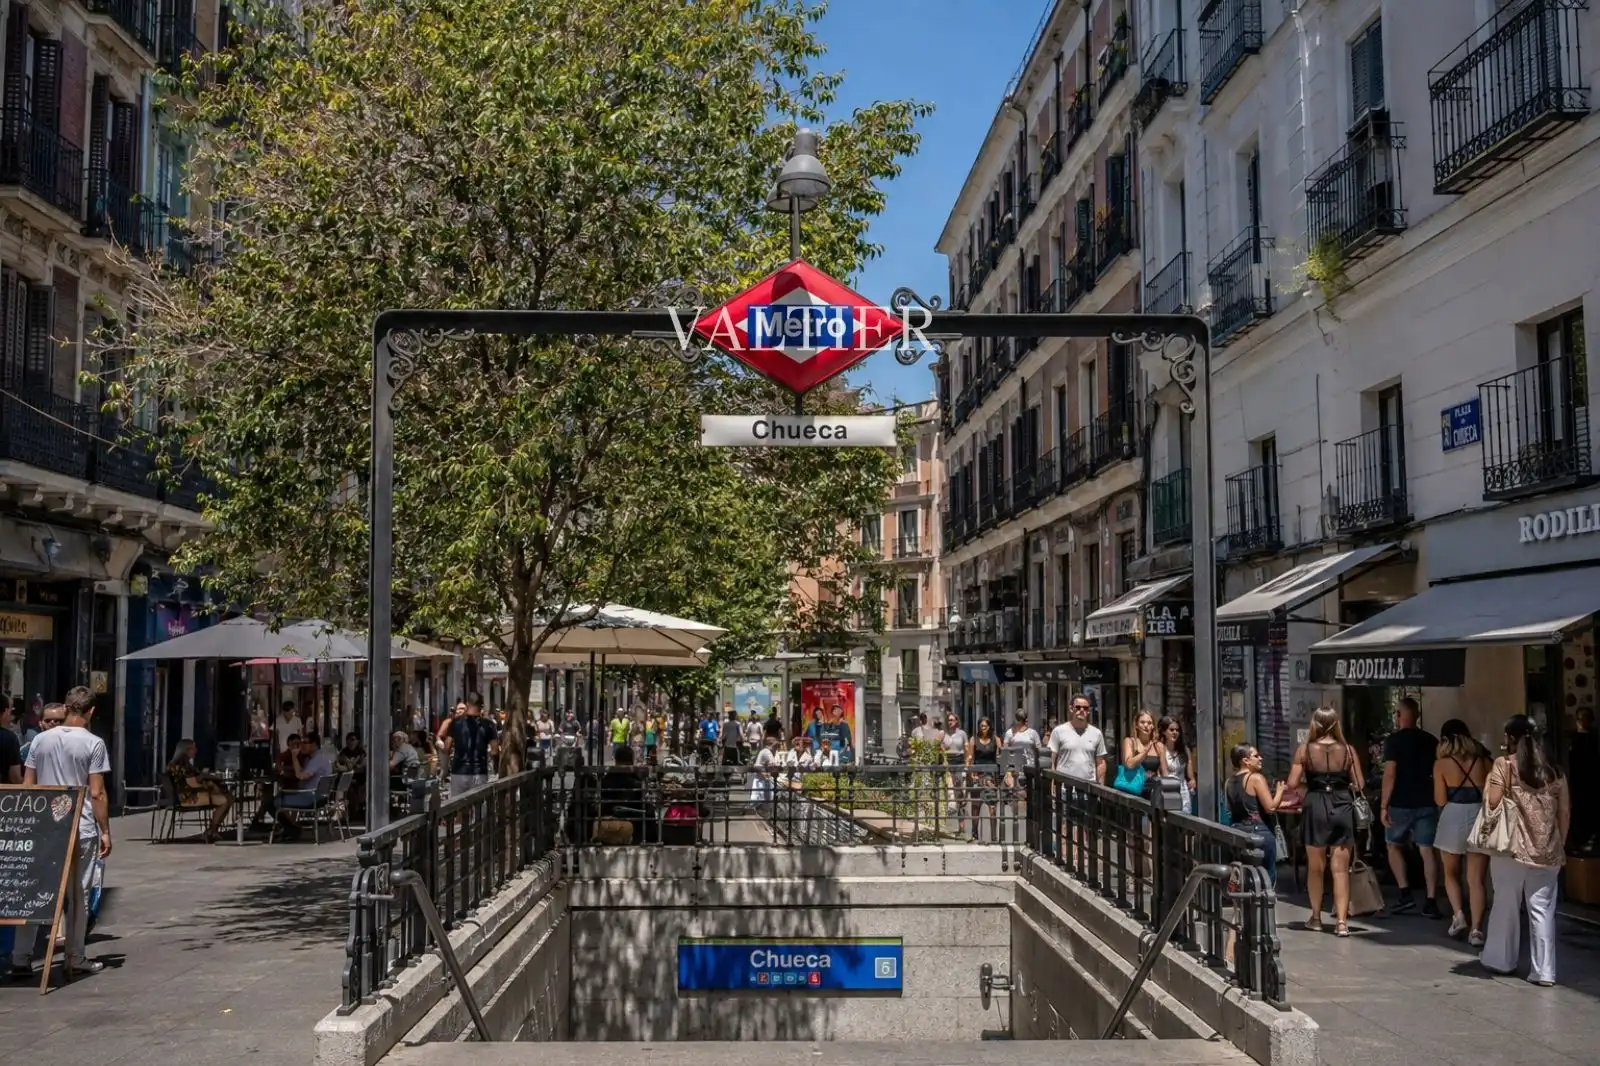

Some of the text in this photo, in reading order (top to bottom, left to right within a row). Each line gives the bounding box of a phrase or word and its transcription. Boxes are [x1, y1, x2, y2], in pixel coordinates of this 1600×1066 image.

[755, 311, 848, 338] Metro
[751, 419, 848, 440] Chueca
[1348, 657, 1405, 680] RODILLA
[750, 949, 832, 969] Chueca
